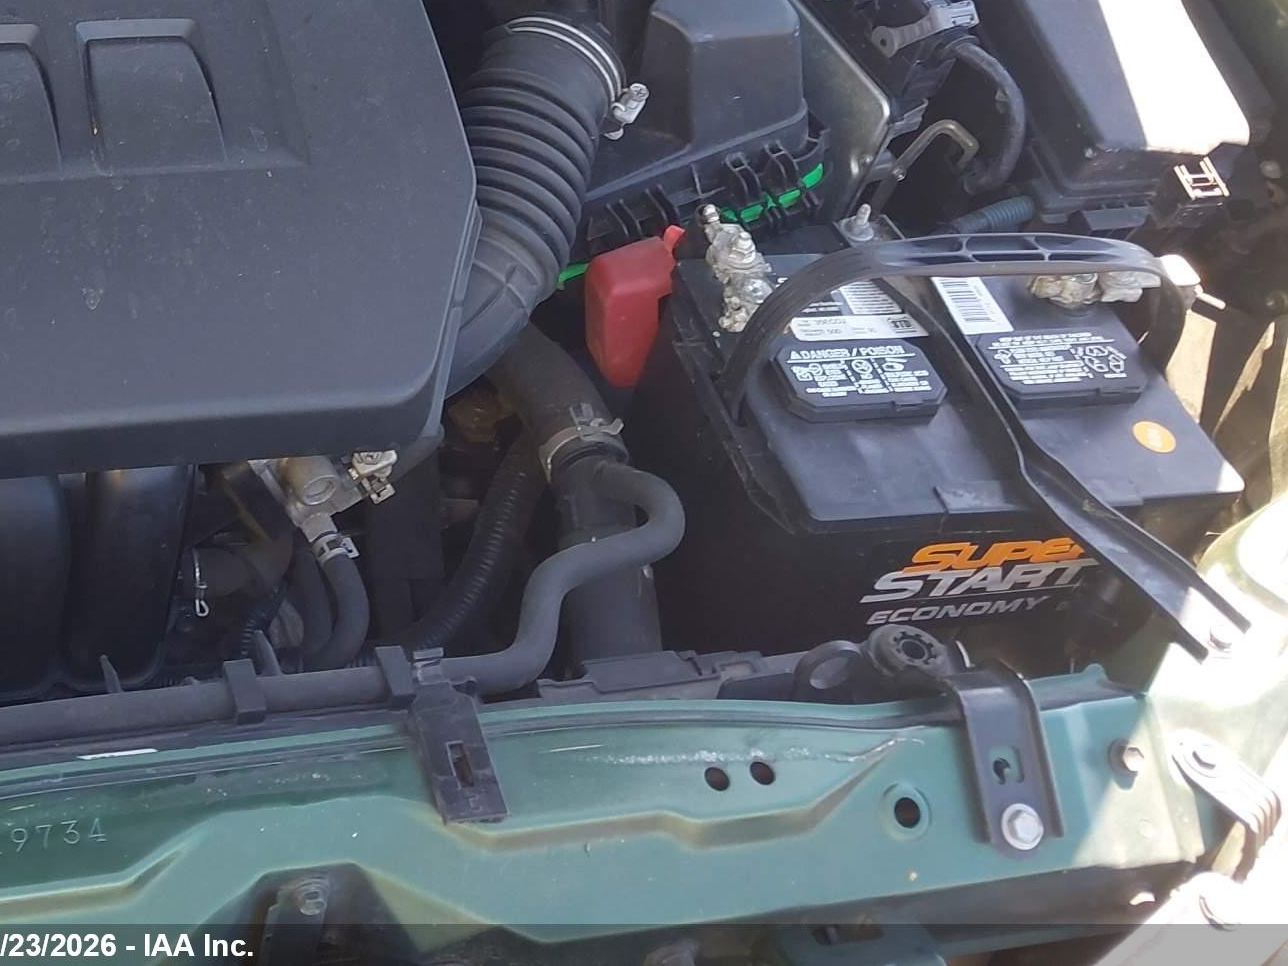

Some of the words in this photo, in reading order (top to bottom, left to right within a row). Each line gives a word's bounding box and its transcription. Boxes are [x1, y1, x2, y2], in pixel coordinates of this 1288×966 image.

[800, 348, 851, 360] DANGER
[861, 345, 906, 357] POISON
[859, 559, 1101, 604] START
[866, 595, 1051, 626] ECONOMY
